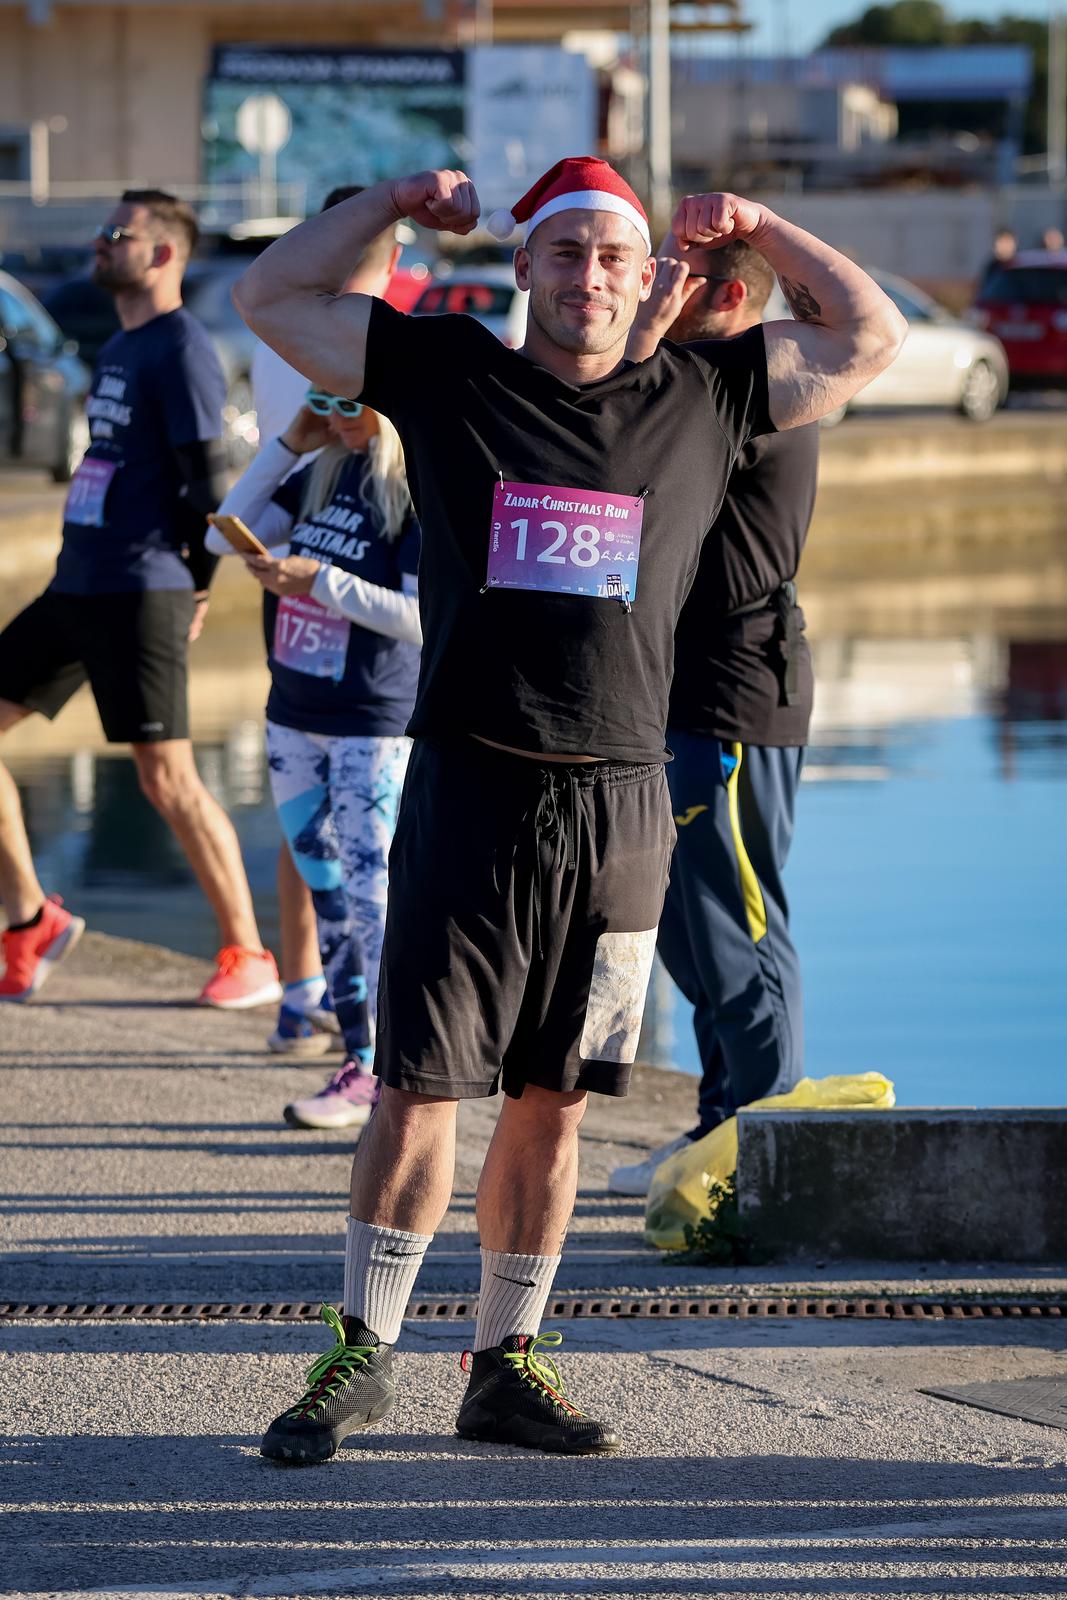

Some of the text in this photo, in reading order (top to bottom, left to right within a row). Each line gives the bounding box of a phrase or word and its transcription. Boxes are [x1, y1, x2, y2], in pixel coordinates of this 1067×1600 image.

[504, 492, 630, 520] ZADAR CHRISTMAS RUN
[510, 518, 601, 568] 128
[281, 612, 323, 654] 175
